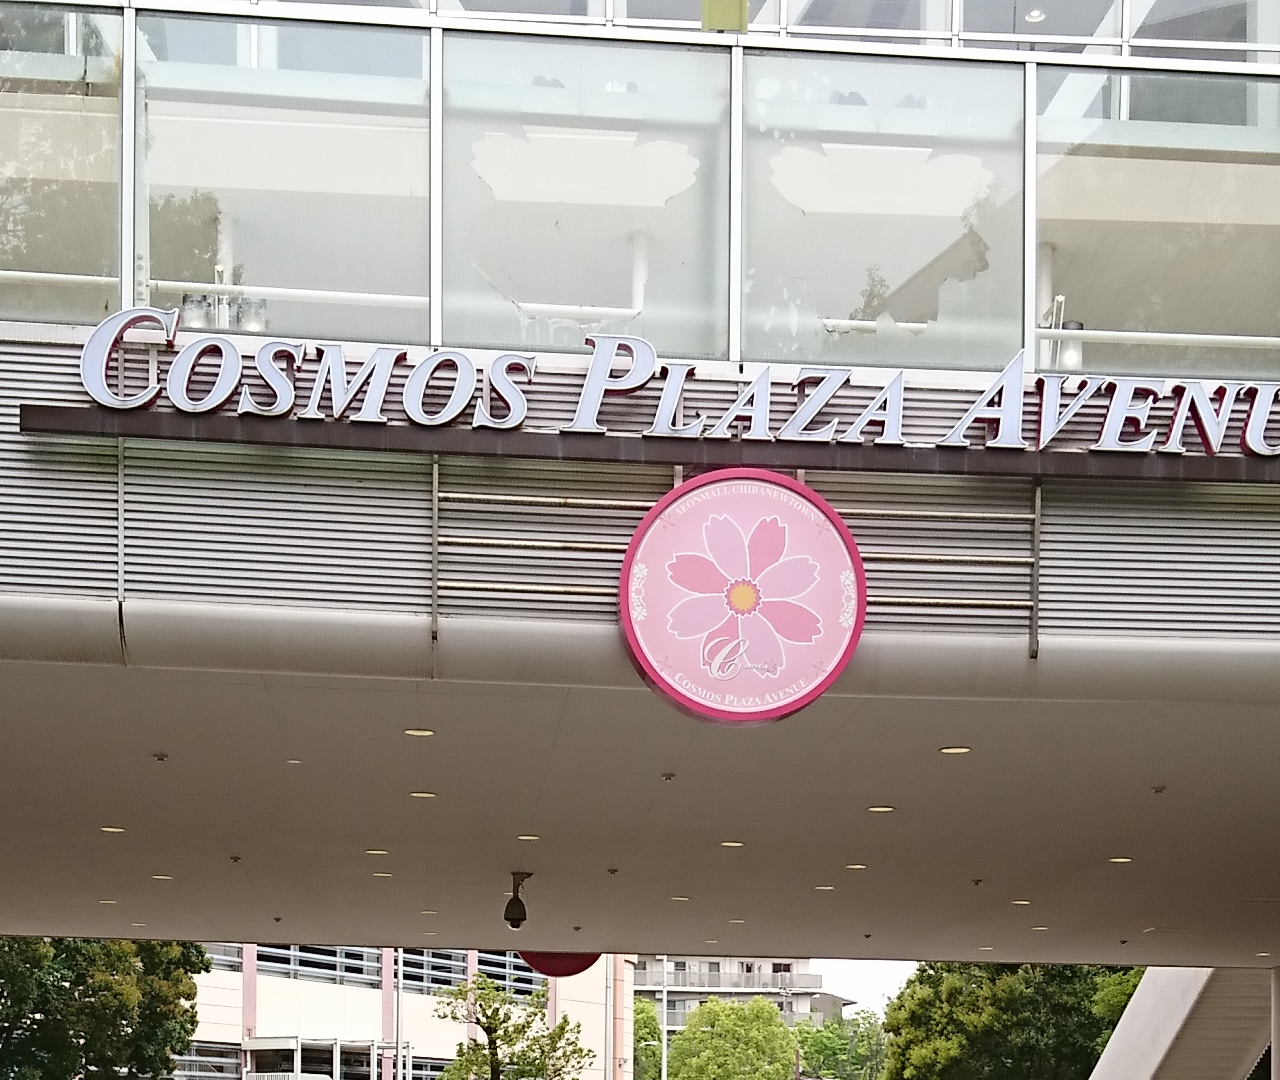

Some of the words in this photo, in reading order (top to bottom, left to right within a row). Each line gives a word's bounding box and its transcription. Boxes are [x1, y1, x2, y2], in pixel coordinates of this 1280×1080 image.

[80, 306, 538, 429] COSMOS
[559, 334, 907, 446] PLAZA
[674, 488, 731, 517] AEONMALL
[732, 485, 818, 522] CHIBANEWTOWN
[674, 672, 722, 704] COSMOS
[724, 693, 762, 706] PLAZA
[764, 678, 809, 705] AVENUE
